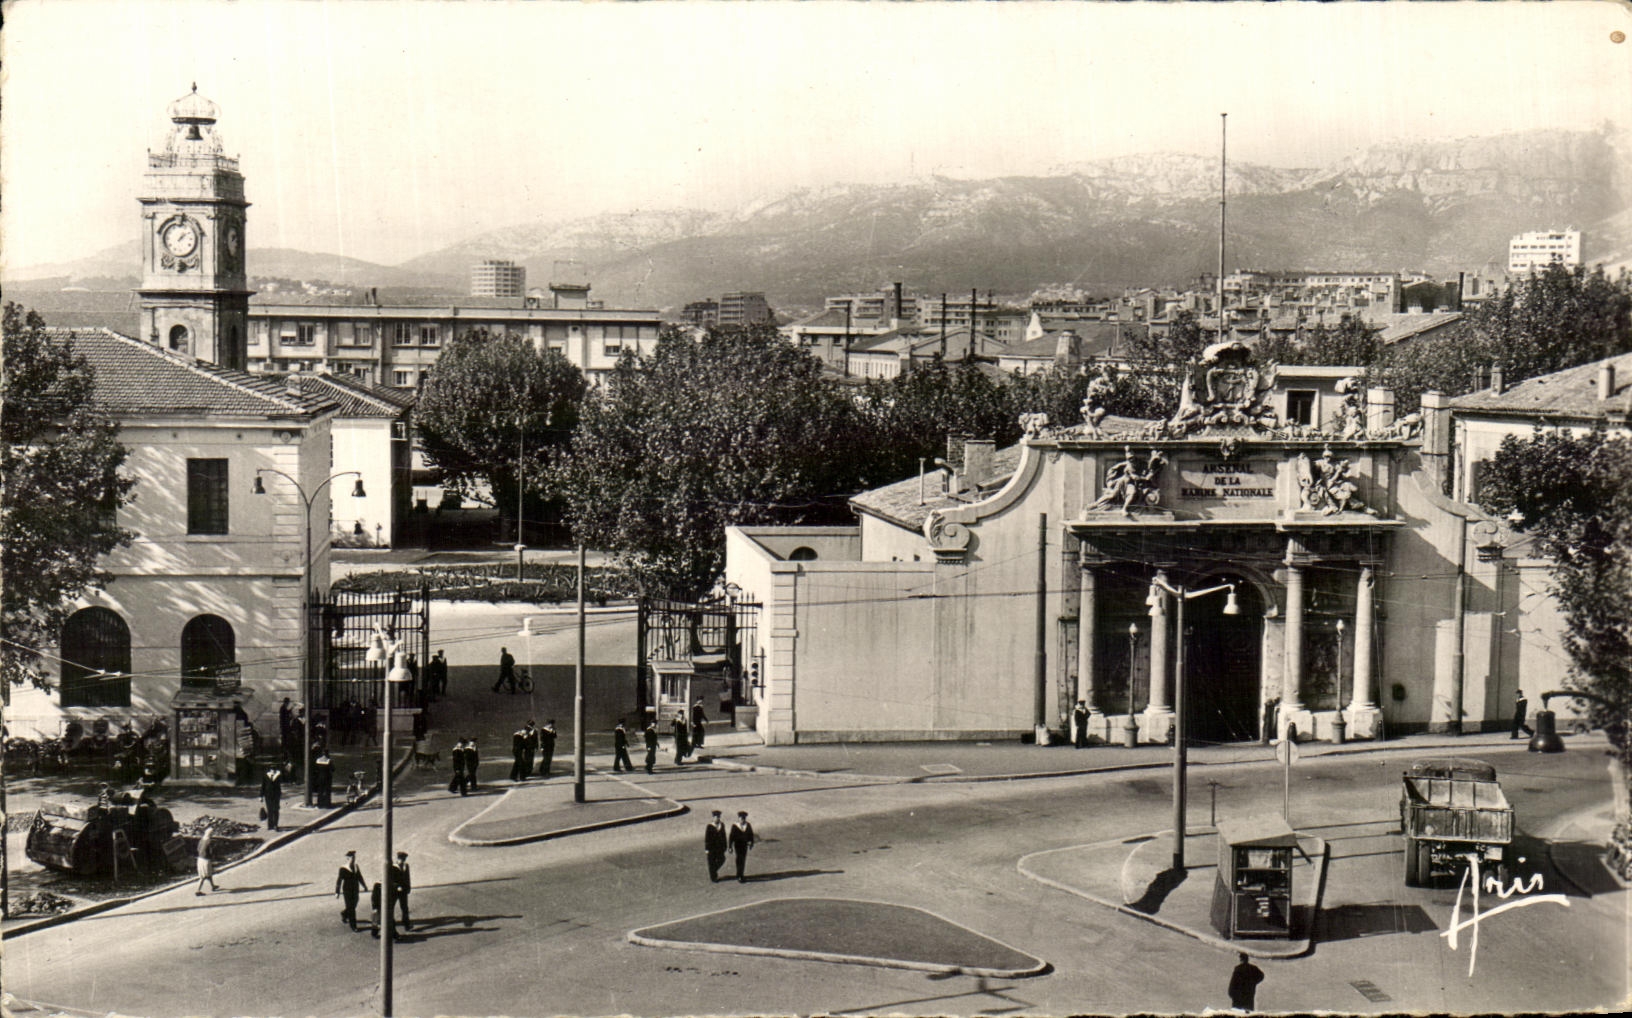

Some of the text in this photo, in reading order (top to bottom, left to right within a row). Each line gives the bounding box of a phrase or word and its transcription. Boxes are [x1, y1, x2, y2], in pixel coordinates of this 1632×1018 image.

[1203, 463, 1253, 473] ARSENAL
[1215, 477, 1240, 485] DE LA
[1181, 488, 1273, 497] MARINE NATIONALE
